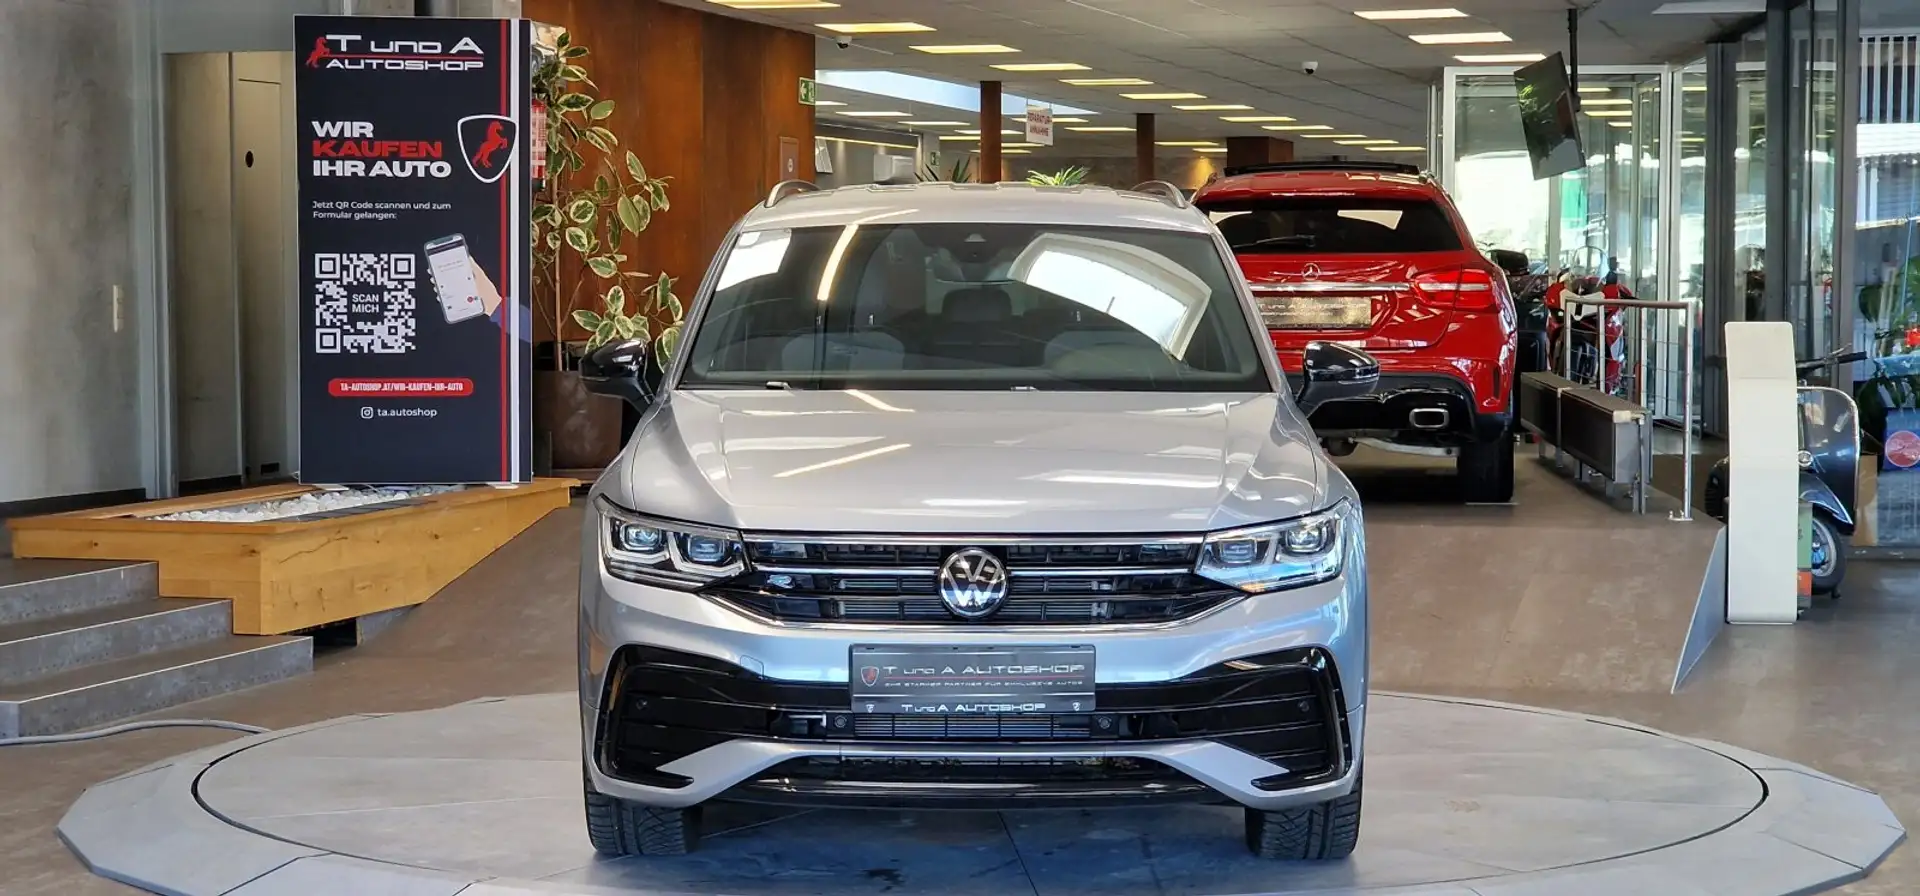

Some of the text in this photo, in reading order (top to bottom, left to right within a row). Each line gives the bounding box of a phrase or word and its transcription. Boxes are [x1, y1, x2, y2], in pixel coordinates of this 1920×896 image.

[326, 34, 361, 52] T
[450, 37, 484, 54] A
[326, 58, 484, 71] AUTOSHOP
[311, 121, 375, 138] WIR
[312, 140, 443, 158] KAUFEN
[313, 160, 452, 178] IHR AUTO
[312, 201, 334, 209] Jetzt
[335, 201, 349, 210] QR
[350, 201, 373, 209] Code
[413, 201, 430, 209] und
[312, 210, 397, 220] Formular gelangen:
[352, 293, 379, 303] SCAN
[352, 303, 379, 313] MICH
[377, 407, 438, 418] ta.autoshop
[883, 665, 898, 675] T
[940, 666, 955, 675] A
[962, 664, 1085, 675] AUTOSHOP
[901, 704, 913, 712] T
[937, 704, 949, 712] A
[955, 703, 1046, 712] AUTOSHOP
